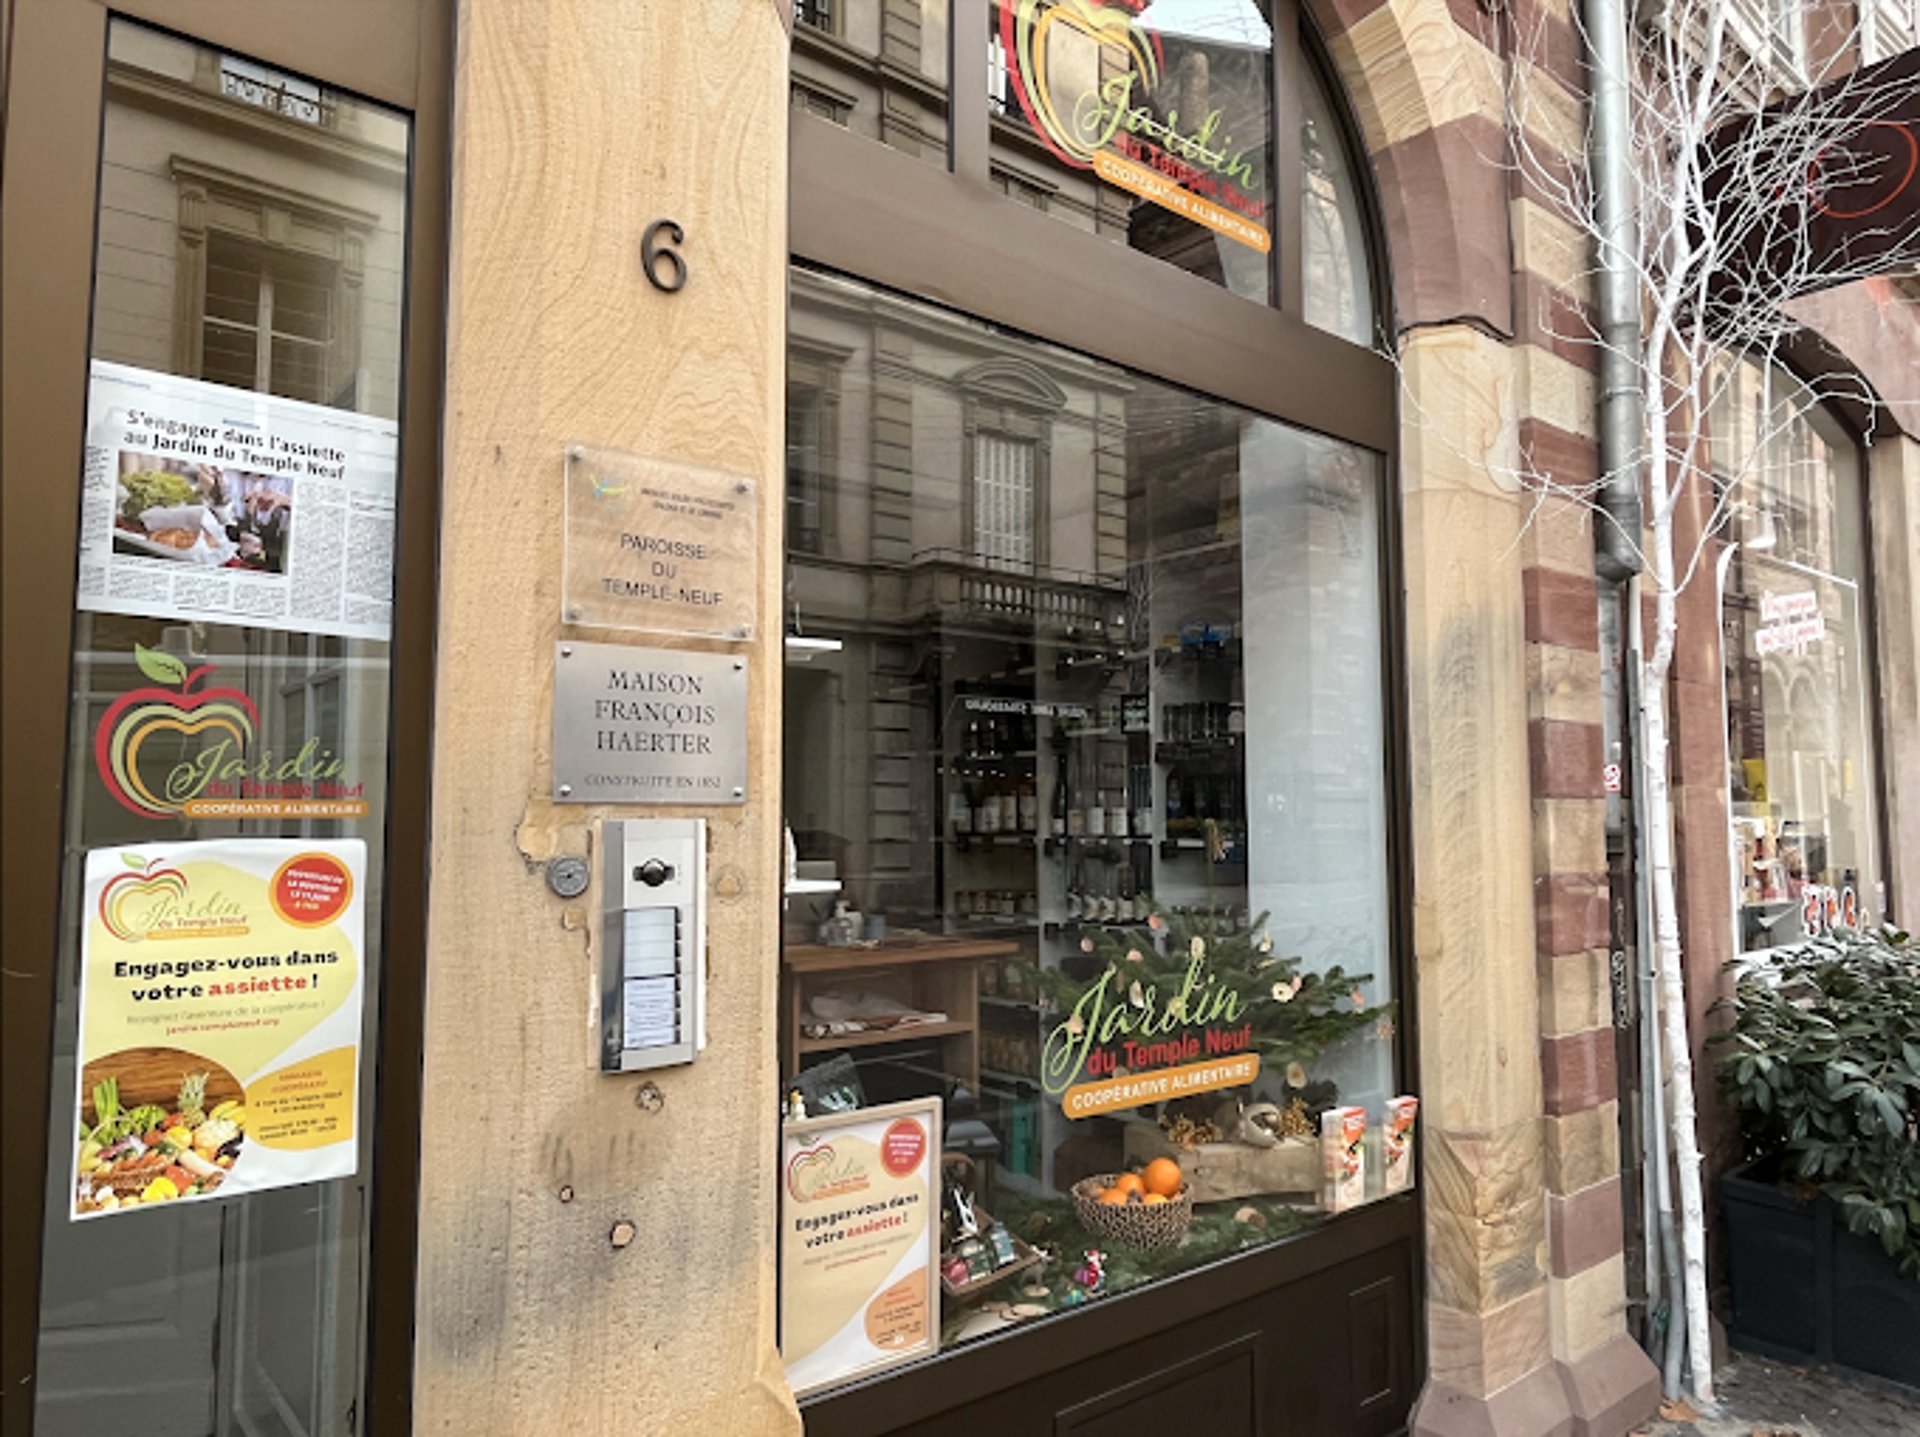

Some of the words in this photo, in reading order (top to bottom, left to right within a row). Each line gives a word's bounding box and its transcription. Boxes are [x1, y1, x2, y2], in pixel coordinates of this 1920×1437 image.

[1073, 70, 1259, 188] Jardin
[640, 219, 687, 294] 6
[126, 408, 218, 439] S'engager
[223, 424, 264, 448] dans
[270, 434, 346, 464] l'assiette
[123, 431, 148, 446] au
[153, 433, 208, 456] Jardin
[213, 443, 236, 461] du
[241, 450, 302, 473] Temple
[307, 461, 346, 480] Neuf
[620, 532, 707, 560] PAROISSE
[651, 561, 678, 579] DU
[602, 578, 724, 606] TEMPLE-NEUF
[607, 669, 704, 695] MAISON
[594, 699, 716, 729] FRANÇOIS
[596, 730, 712, 755] HAERTER
[166, 736, 351, 804] Jardin
[675, 775, 693, 788] EN
[242, 779, 312, 801] Temple
[284, 803, 363, 815] ALIMENTAIRE
[113, 954, 281, 980] Engagez-vous
[285, 949, 339, 966] dans
[131, 982, 204, 1002] votre
[207, 973, 308, 997] assiette
[311, 972, 318, 989] !
[1041, 952, 1248, 1094] Jardin
[1087, 1047, 1117, 1075] du
[1122, 1031, 1200, 1067] Temple
[1205, 1023, 1253, 1054] Neuf
[1071, 1075, 1169, 1111] COOPÉRATIVE
[1171, 1062, 1251, 1090] ALIMENTAIRE
[795, 1201, 887, 1232] Engagez-vous
[889, 1193, 919, 1207] dans
[805, 1230, 845, 1249] votre
[847, 1215, 902, 1238] assiette
